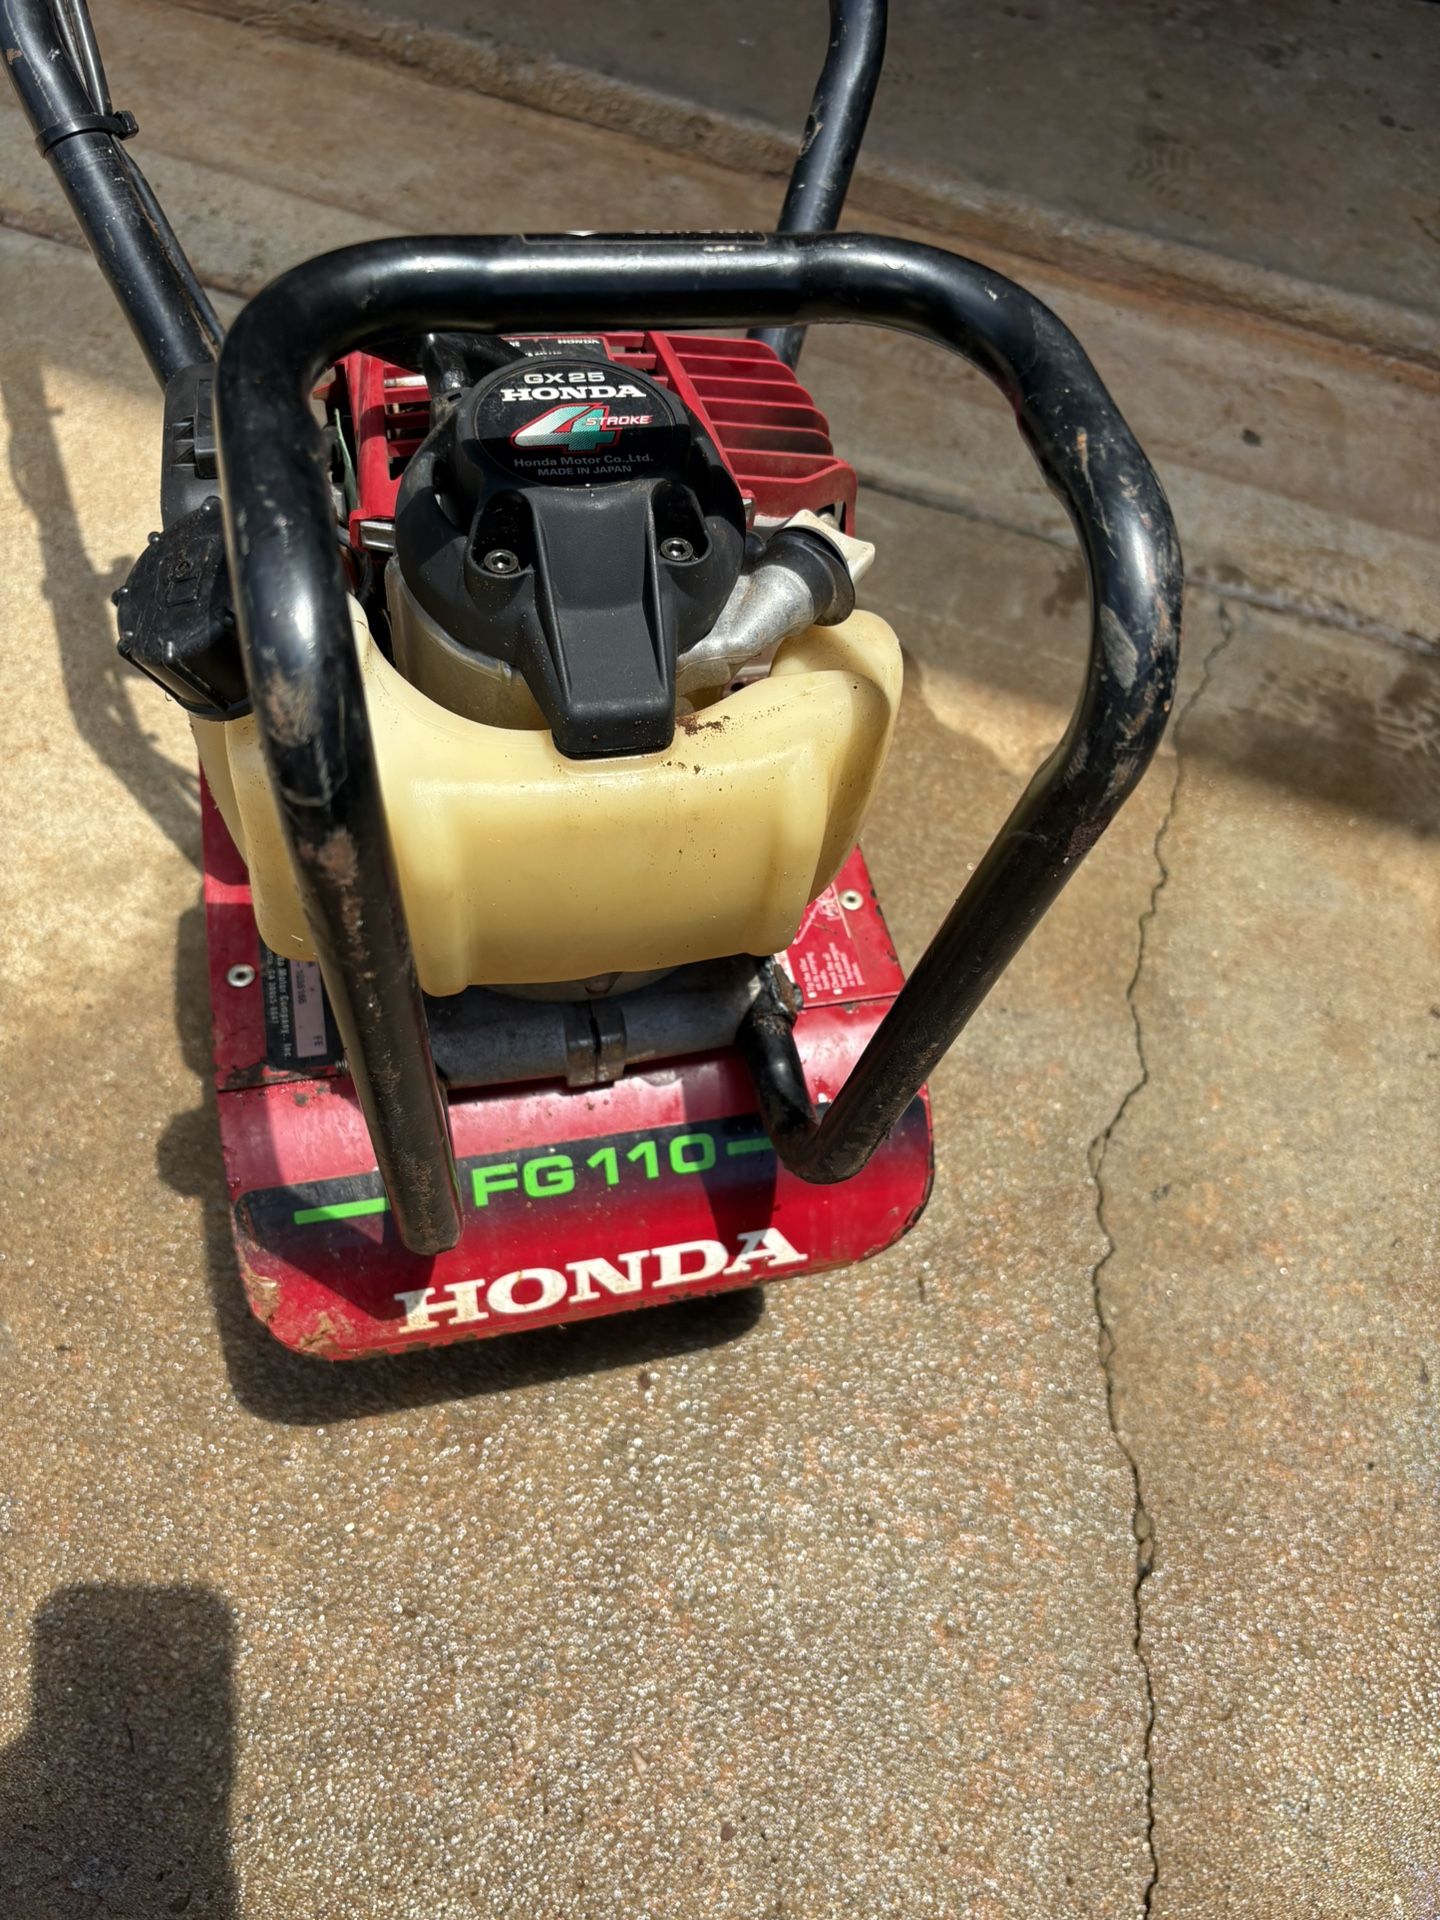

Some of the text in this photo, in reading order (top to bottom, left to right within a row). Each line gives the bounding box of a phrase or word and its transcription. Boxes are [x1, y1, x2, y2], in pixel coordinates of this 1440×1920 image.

[500, 384, 647, 402] HONDA
[512, 402, 653, 452] 4 STROKE
[513, 457, 558, 468] Honda
[560, 455, 601, 466] Motor
[537, 464, 633, 477] MADE IN JAPAN
[394, 1227, 808, 1334] HONDA
